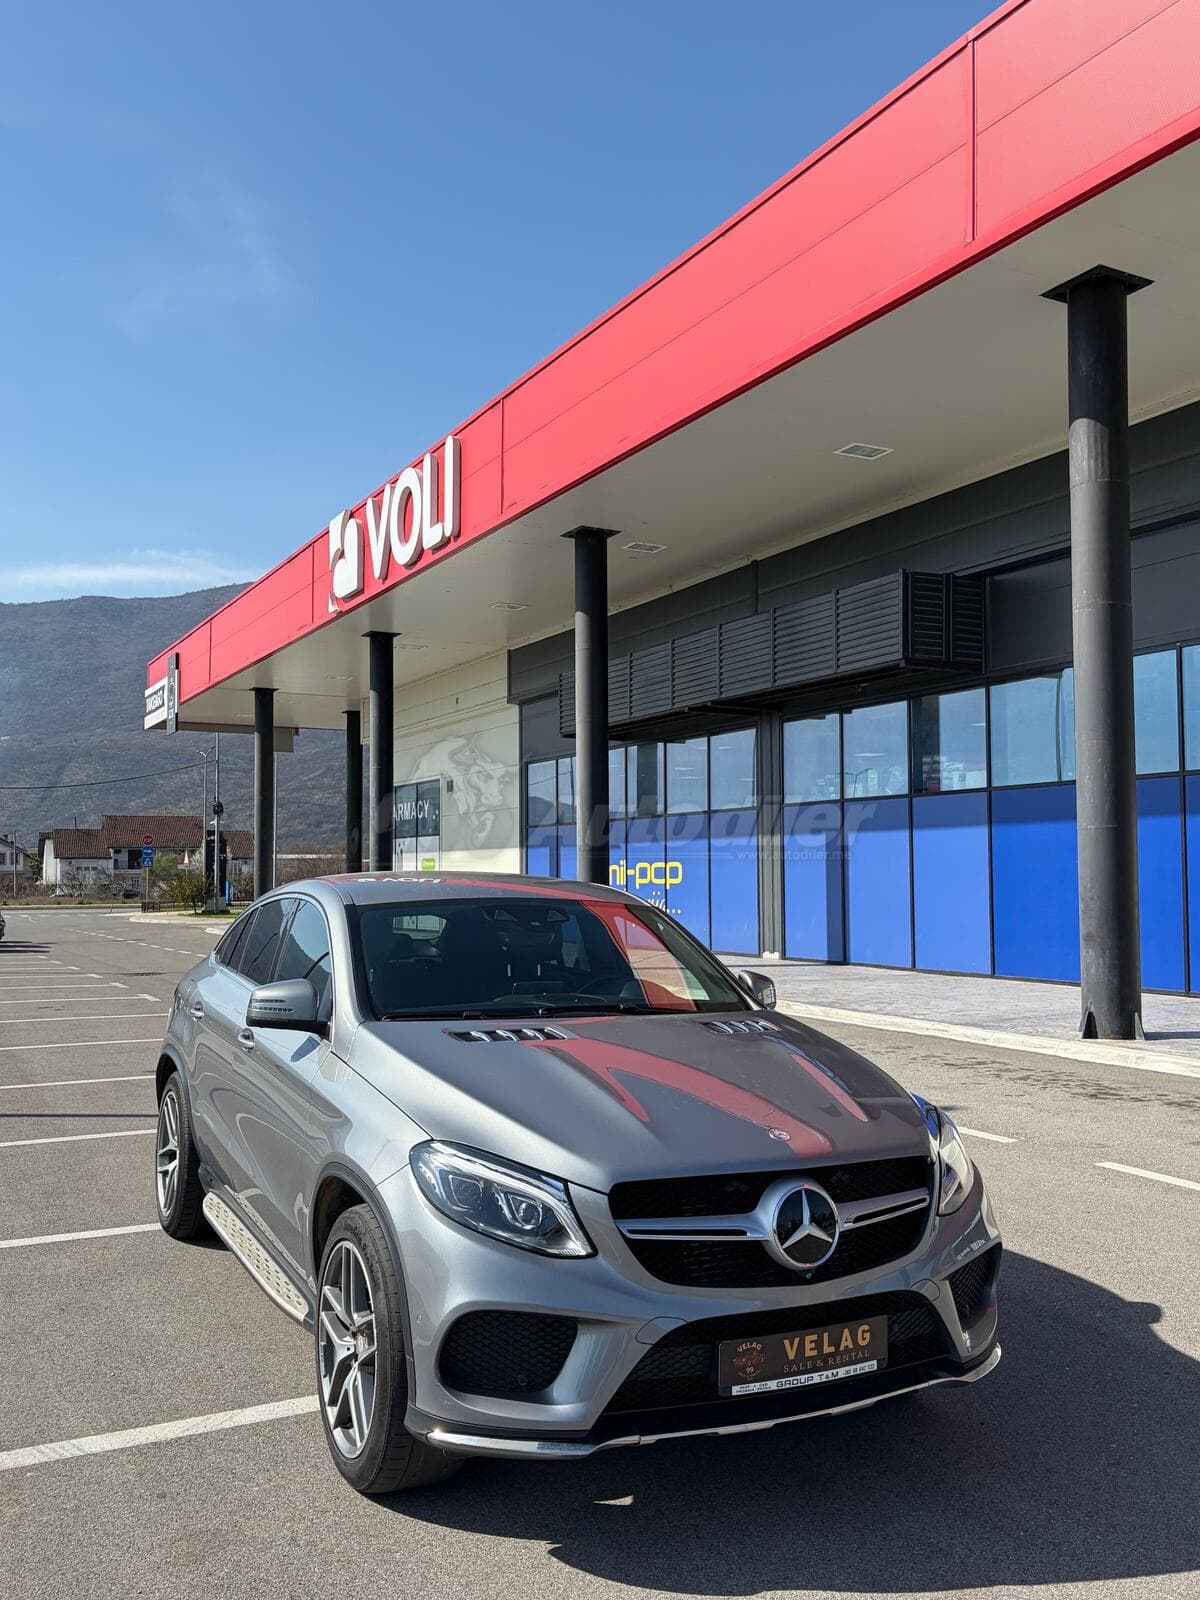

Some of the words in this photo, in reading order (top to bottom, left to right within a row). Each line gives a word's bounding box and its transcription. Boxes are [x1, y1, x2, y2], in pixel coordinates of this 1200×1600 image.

[366, 435, 461, 579] VOLI
[783, 1324, 871, 1360] VELAG
[783, 1361, 813, 1373] SALE
[816, 1359, 825, 1367] &
[828, 1349, 870, 1365] RENTAL
[776, 1375, 814, 1388] GROUP
